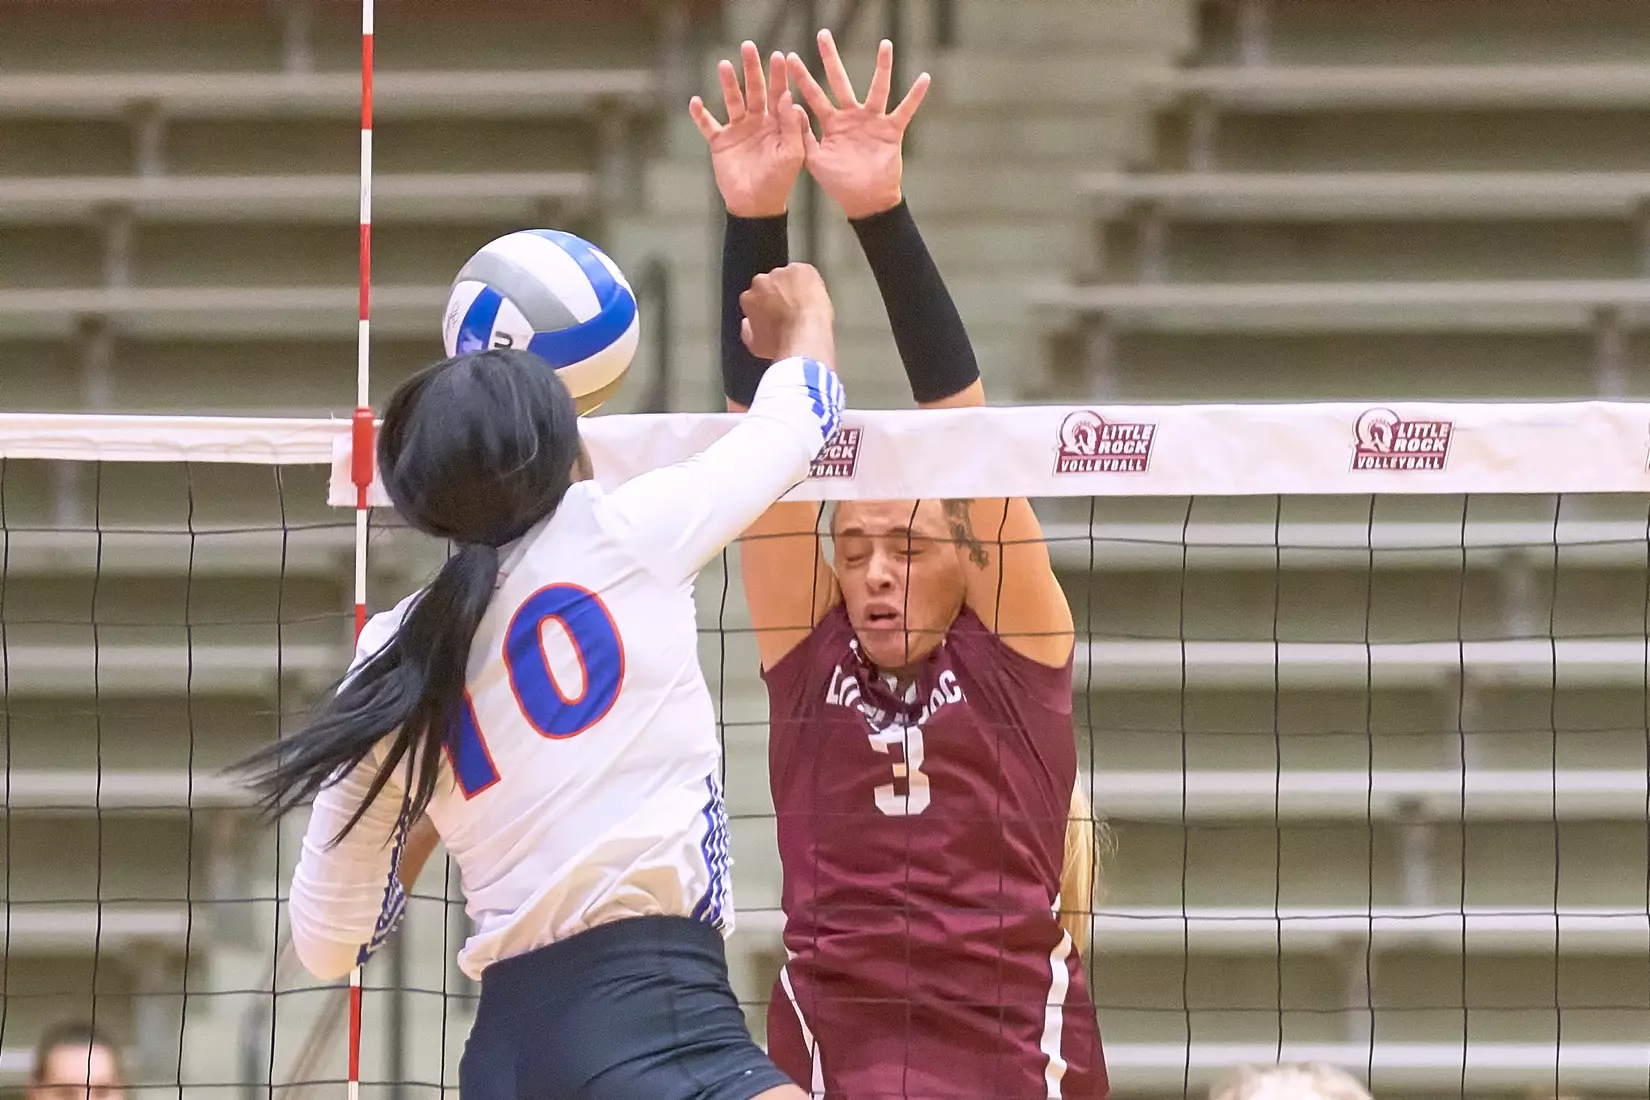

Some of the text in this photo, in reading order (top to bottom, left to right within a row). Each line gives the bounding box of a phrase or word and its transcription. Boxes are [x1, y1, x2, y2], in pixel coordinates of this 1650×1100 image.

[1101, 425, 1153, 440] LITTLE
[1397, 422, 1449, 438] LITTLE
[1098, 440, 1149, 454] ROCK
[1393, 438, 1446, 452] ROCK
[1061, 458, 1142, 472] VOLLEYBALL
[1357, 456, 1440, 469] VOLLEYBALL
[868, 725, 931, 816] 3
